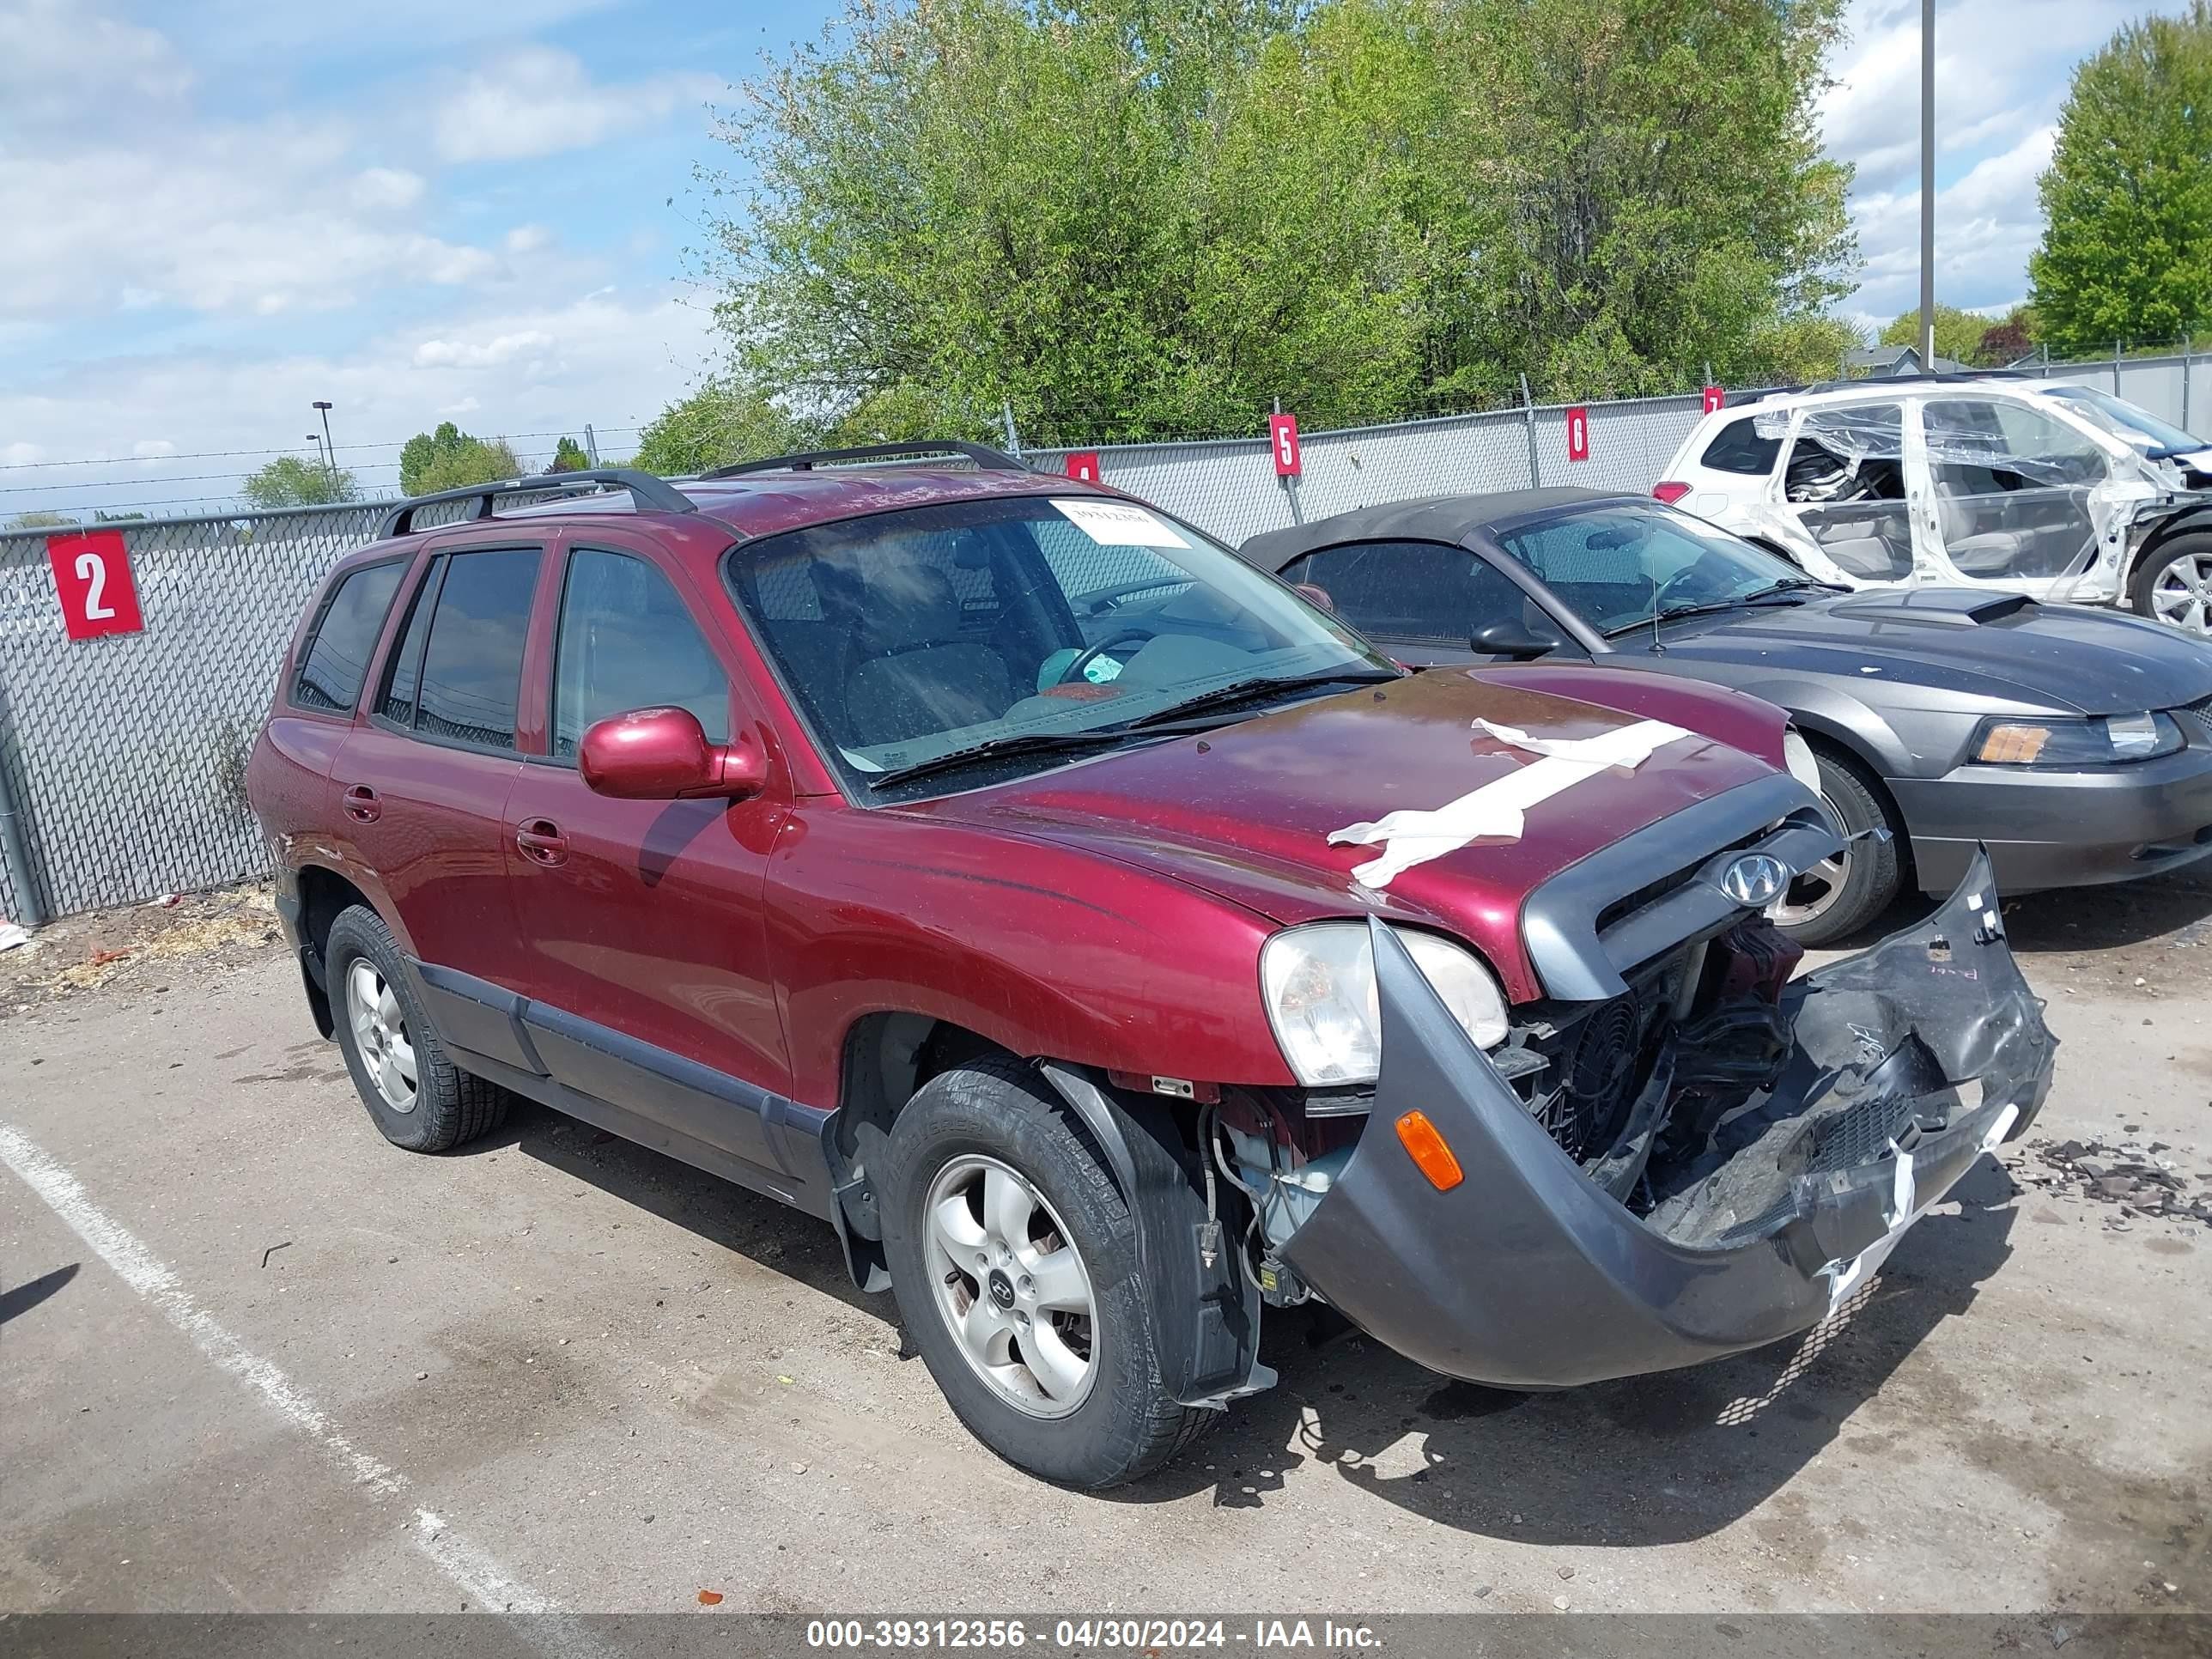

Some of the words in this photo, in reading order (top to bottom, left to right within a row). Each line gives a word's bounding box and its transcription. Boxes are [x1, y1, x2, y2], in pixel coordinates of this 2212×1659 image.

[1279, 427, 1292, 465] 5
[1573, 417, 1583, 453] 6
[75, 553, 116, 620] 2
